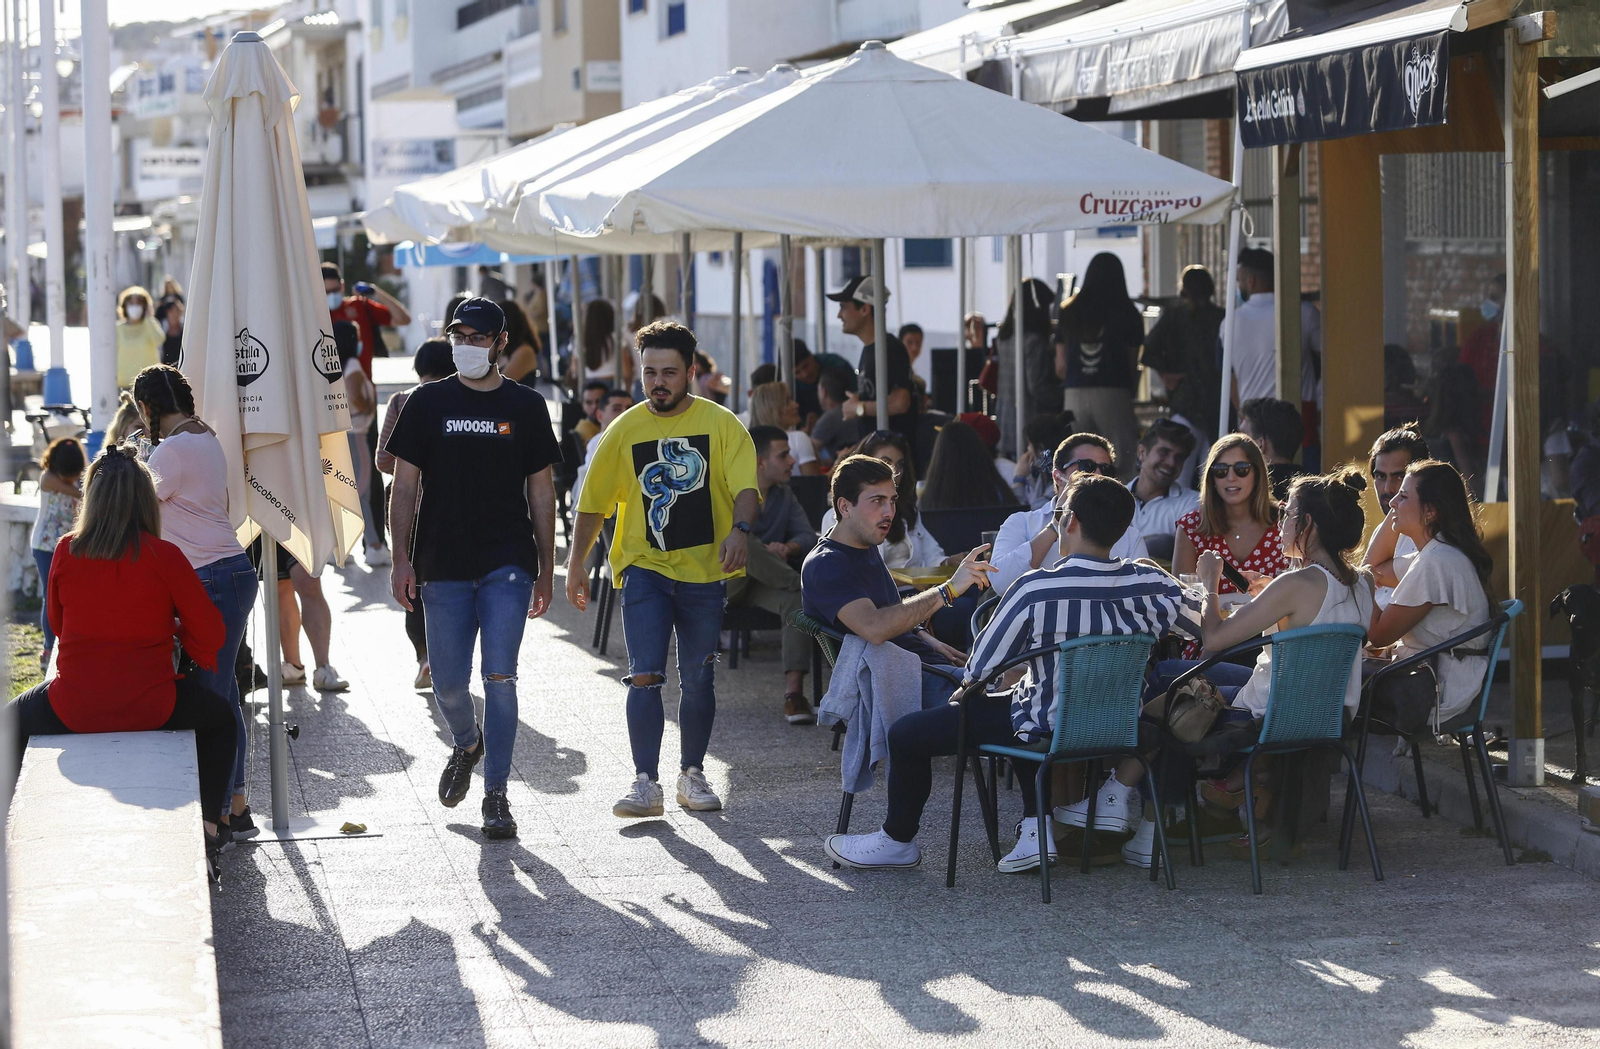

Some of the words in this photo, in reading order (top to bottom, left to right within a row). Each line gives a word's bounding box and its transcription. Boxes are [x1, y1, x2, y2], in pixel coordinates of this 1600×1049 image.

[1080, 191, 1202, 216] Cruzcampo
[446, 419, 498, 434] SWOOSH.
[247, 475, 282, 509] Xacobeo
[280, 505, 297, 523] 2021
